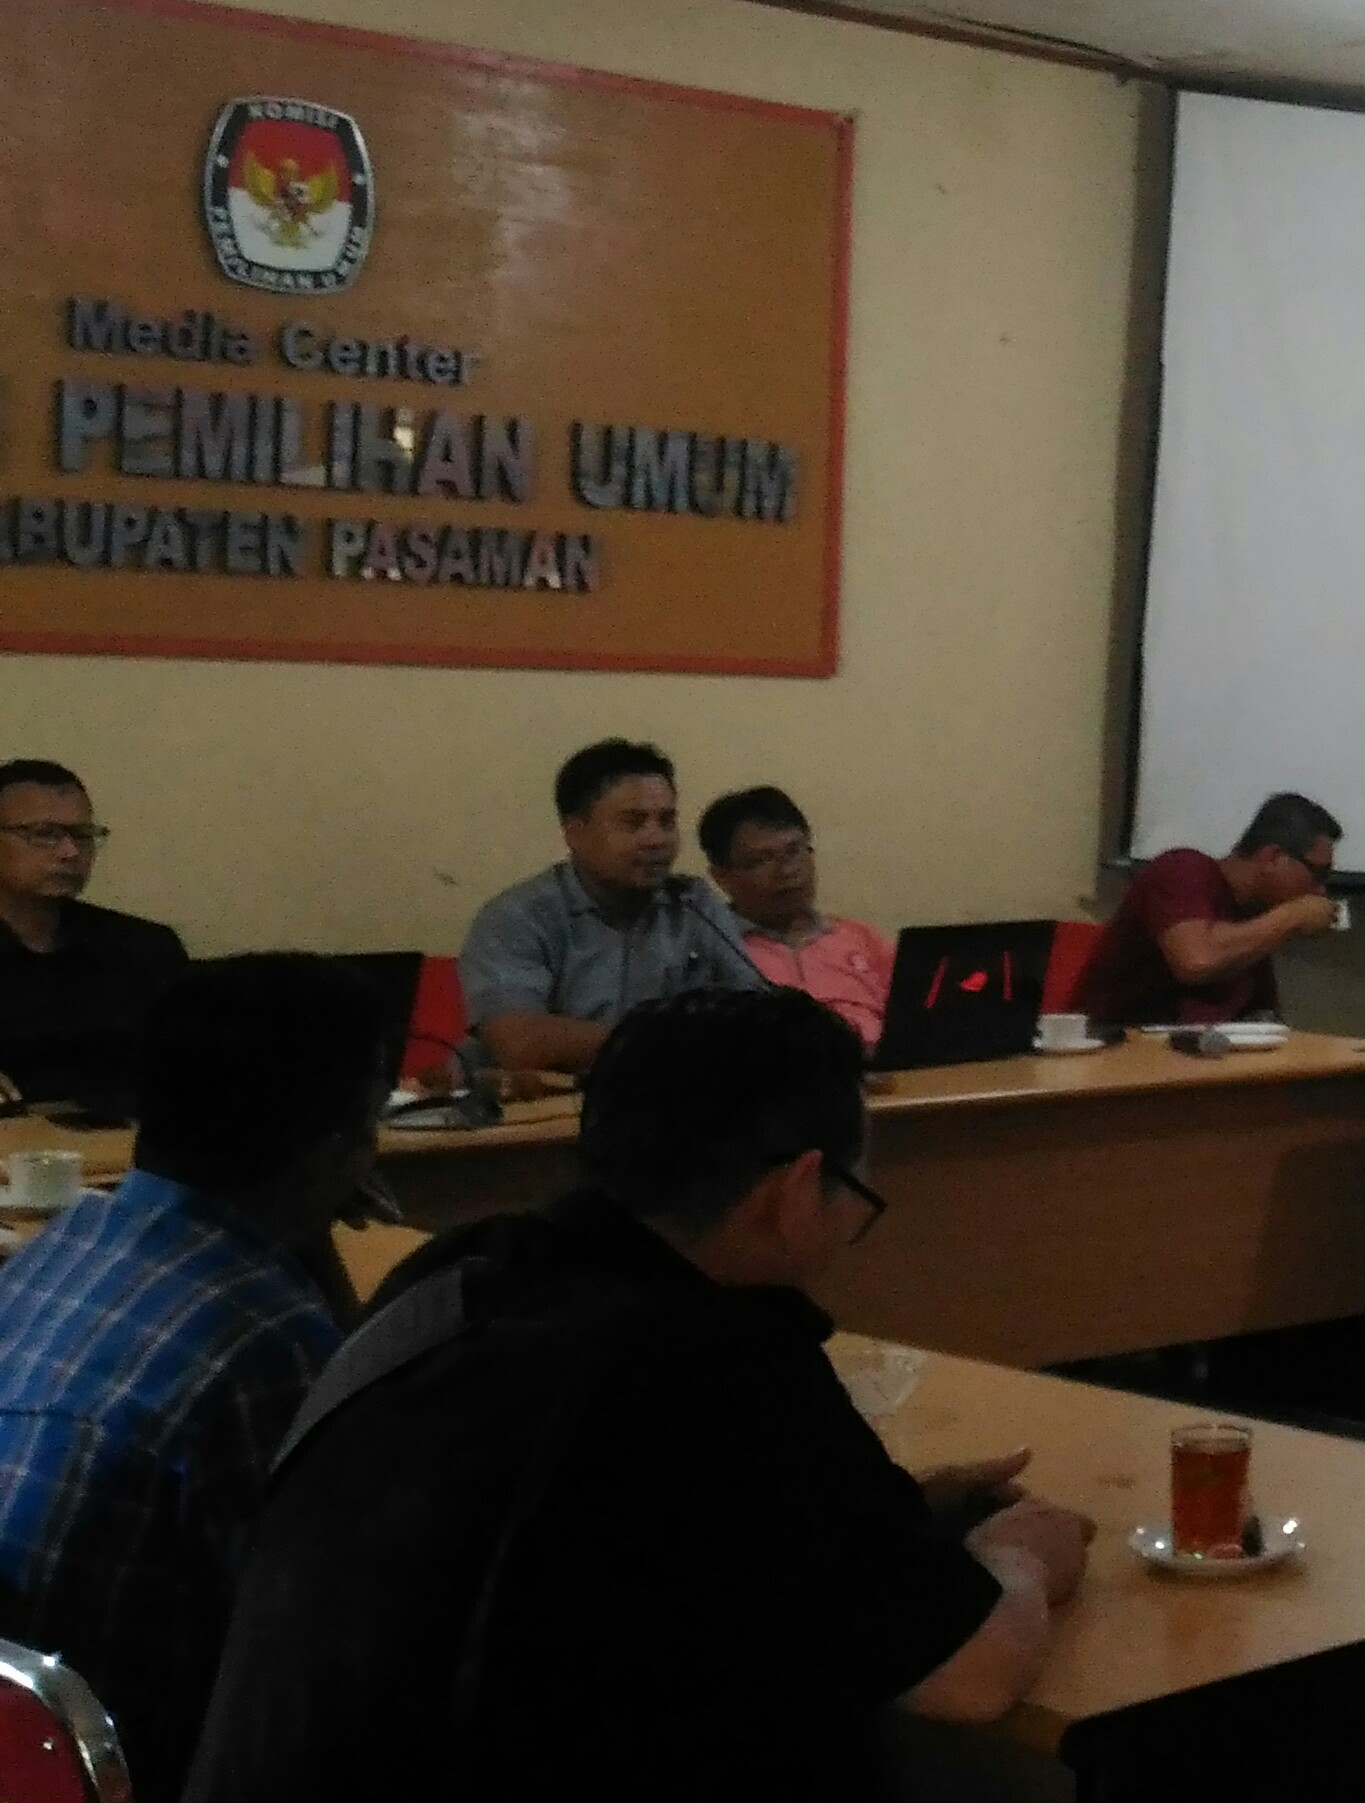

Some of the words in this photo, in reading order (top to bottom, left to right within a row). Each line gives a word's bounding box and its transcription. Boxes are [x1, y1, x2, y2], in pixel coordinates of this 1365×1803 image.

[68, 296, 253, 366] Media
[279, 318, 481, 386] Center
[56, 377, 534, 503] PEMILIHAN
[573, 420, 798, 523] UMUM
[0, 496, 303, 578] BUPATEN
[330, 517, 594, 592] PASAMAN
